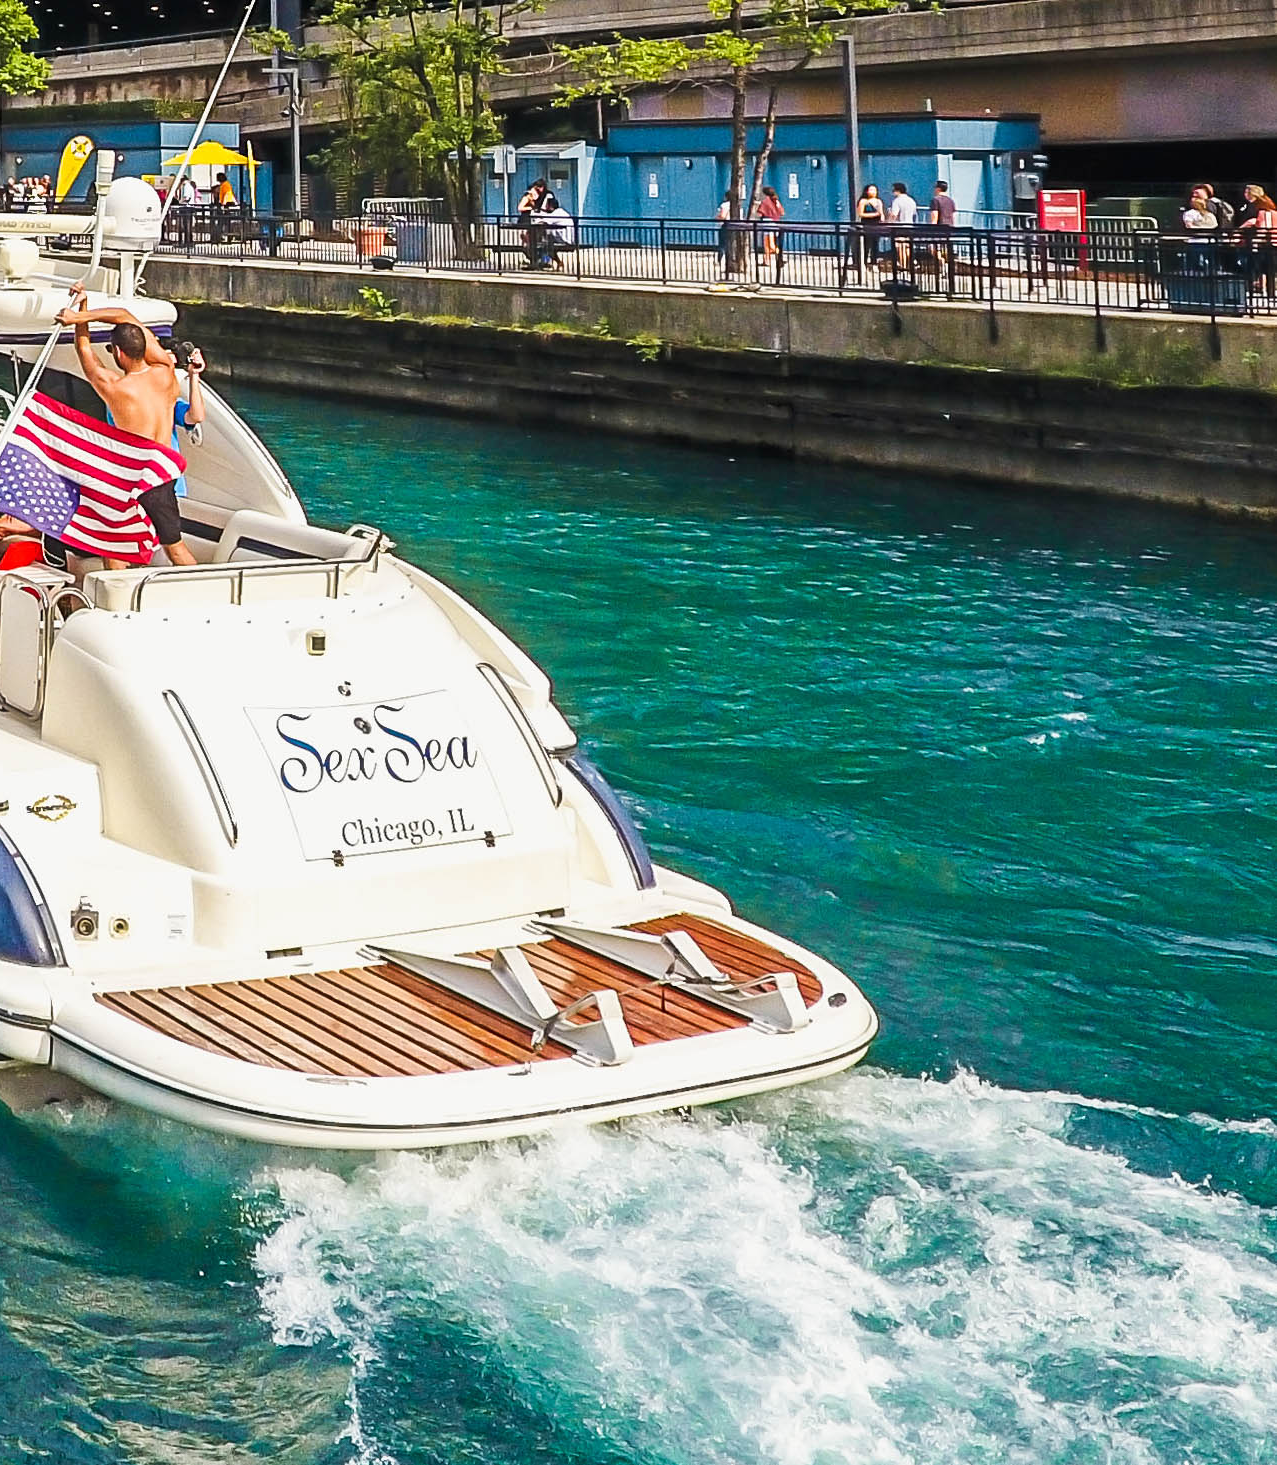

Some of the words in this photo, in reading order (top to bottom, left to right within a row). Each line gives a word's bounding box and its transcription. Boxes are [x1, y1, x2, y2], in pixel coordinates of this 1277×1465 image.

[276, 713, 377, 793] Sex
[373, 704, 478, 783] Sea
[341, 817, 443, 845] Chicago,
[446, 808, 475, 833] IL
